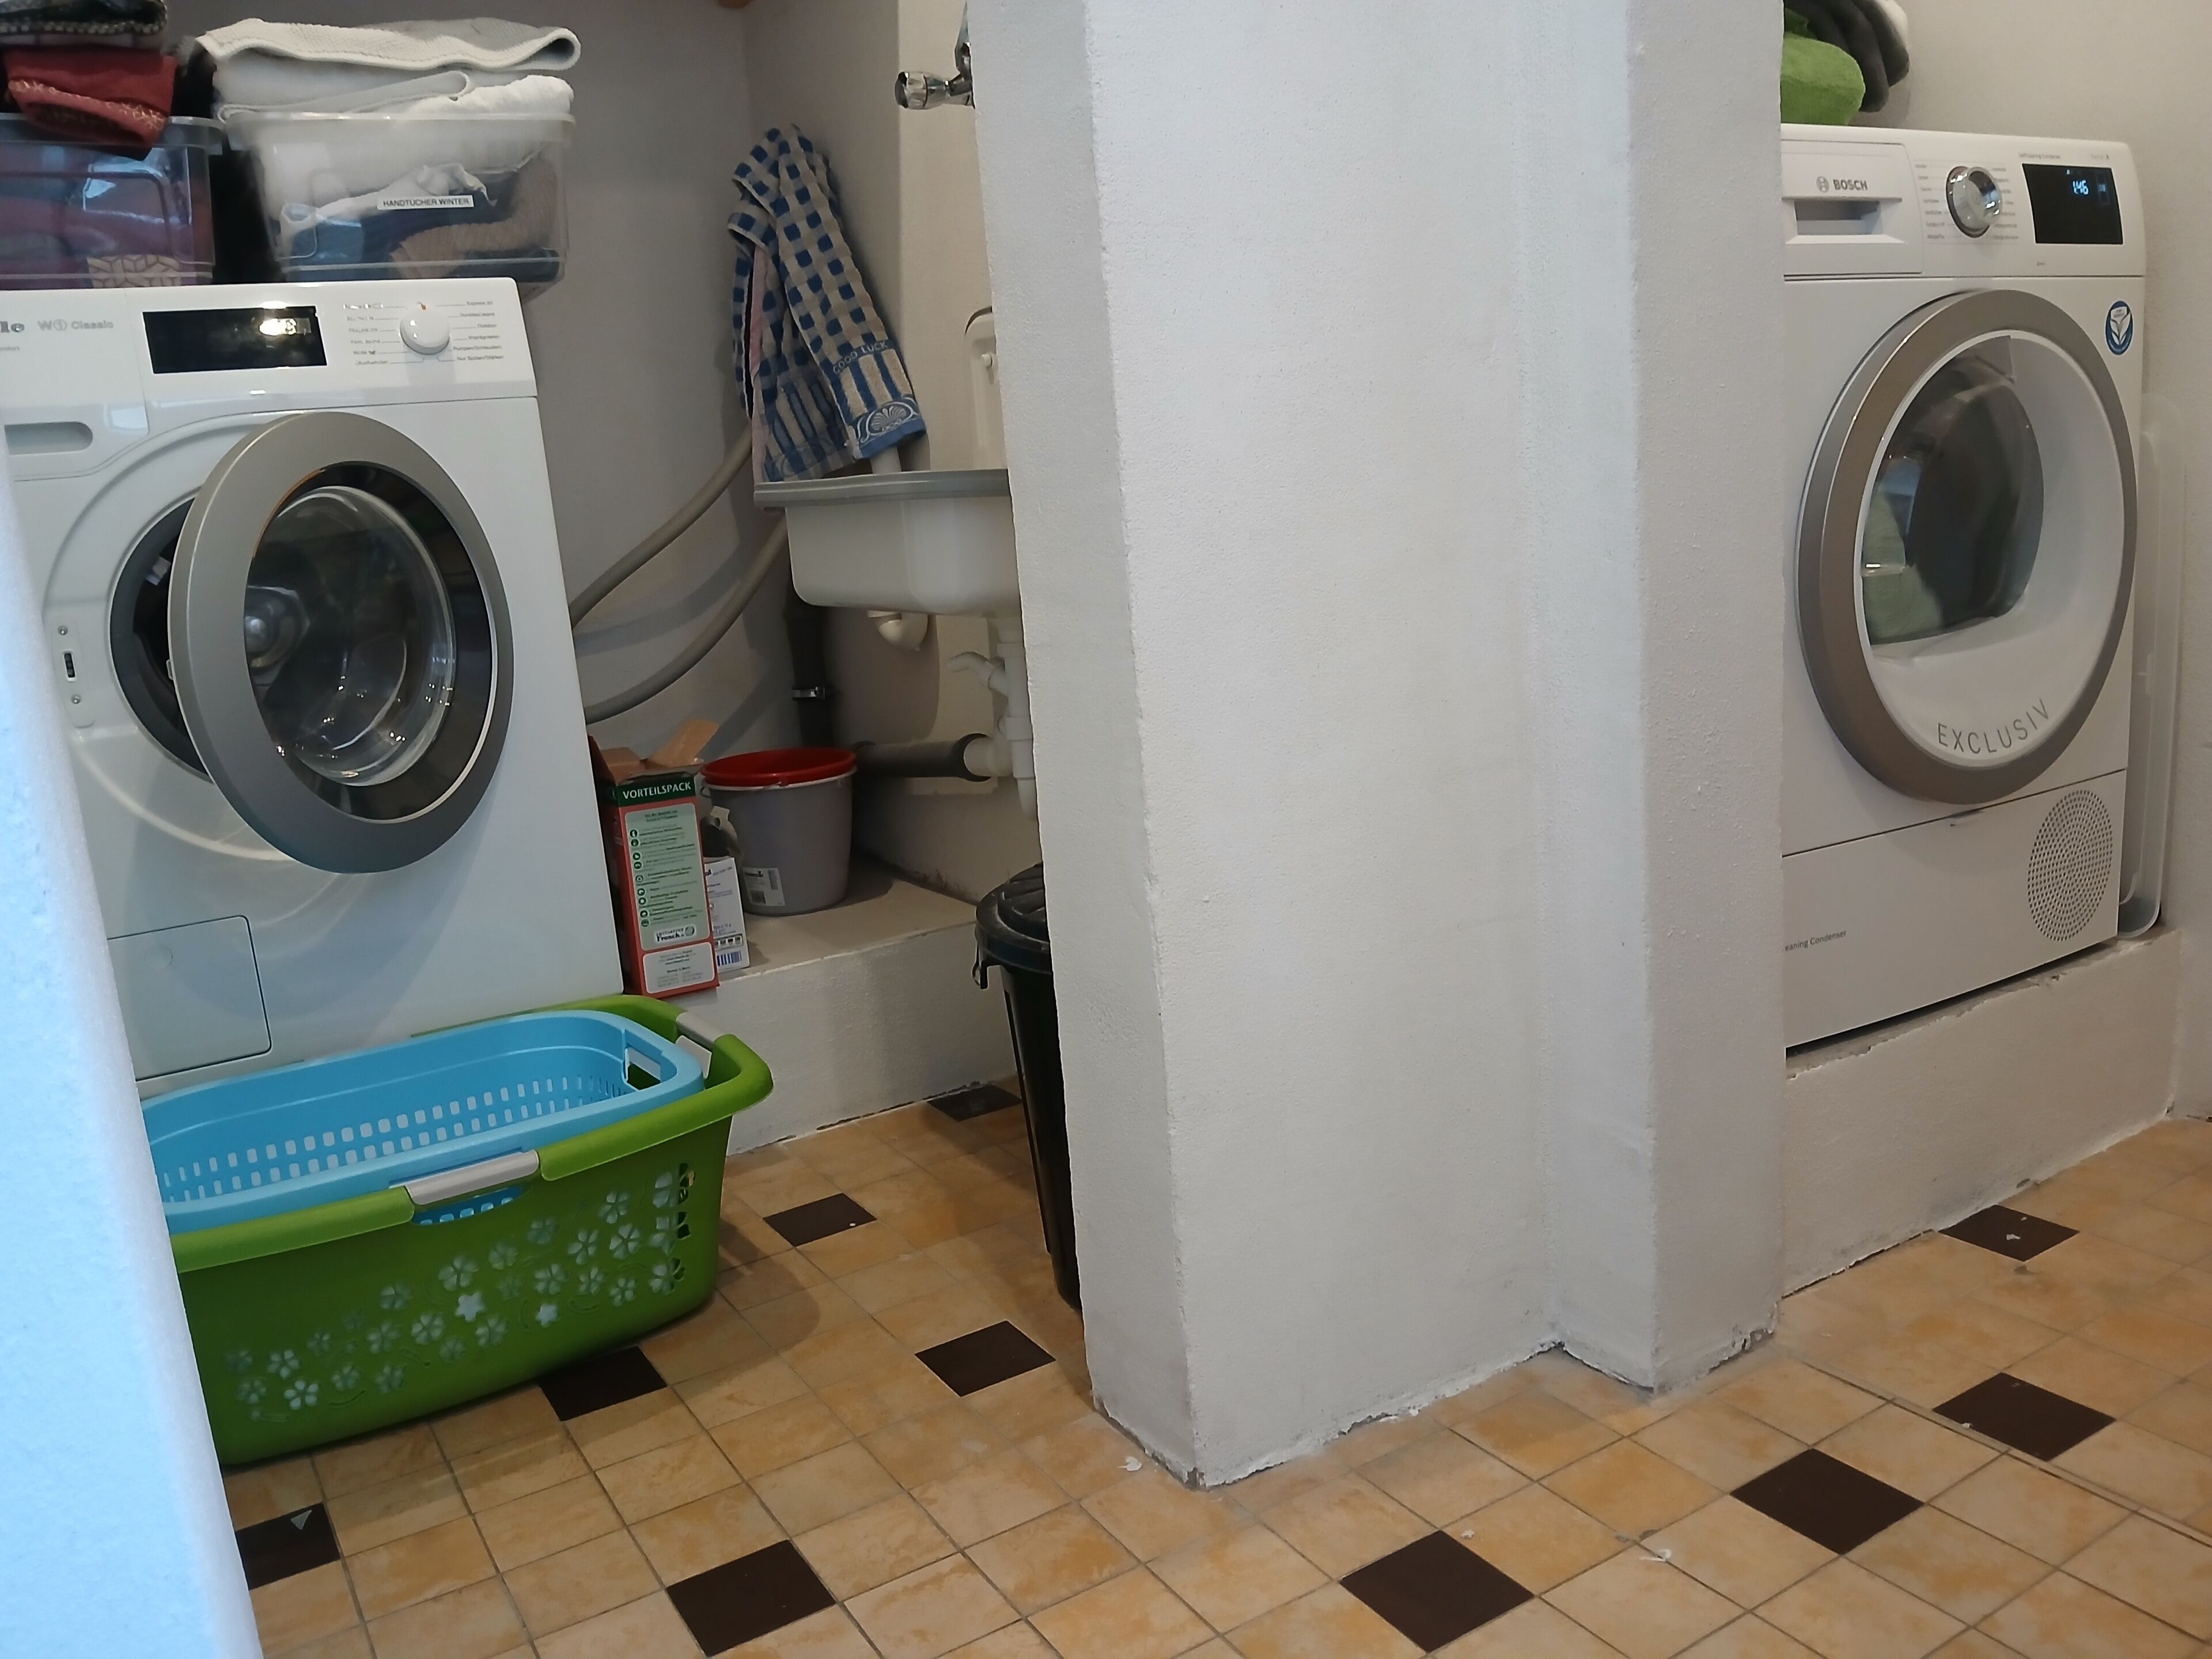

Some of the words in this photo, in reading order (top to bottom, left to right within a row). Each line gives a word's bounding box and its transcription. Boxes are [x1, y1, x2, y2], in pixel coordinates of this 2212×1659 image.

[1833, 179, 1868, 191] BOSCH
[833, 351, 858, 374] GOOD
[861, 340, 888, 354] LUCK
[1938, 698, 2049, 754] EXCLUSIV
[623, 782, 691, 800] VORTEILSPACK
[1810, 930, 1847, 945] Condenser
